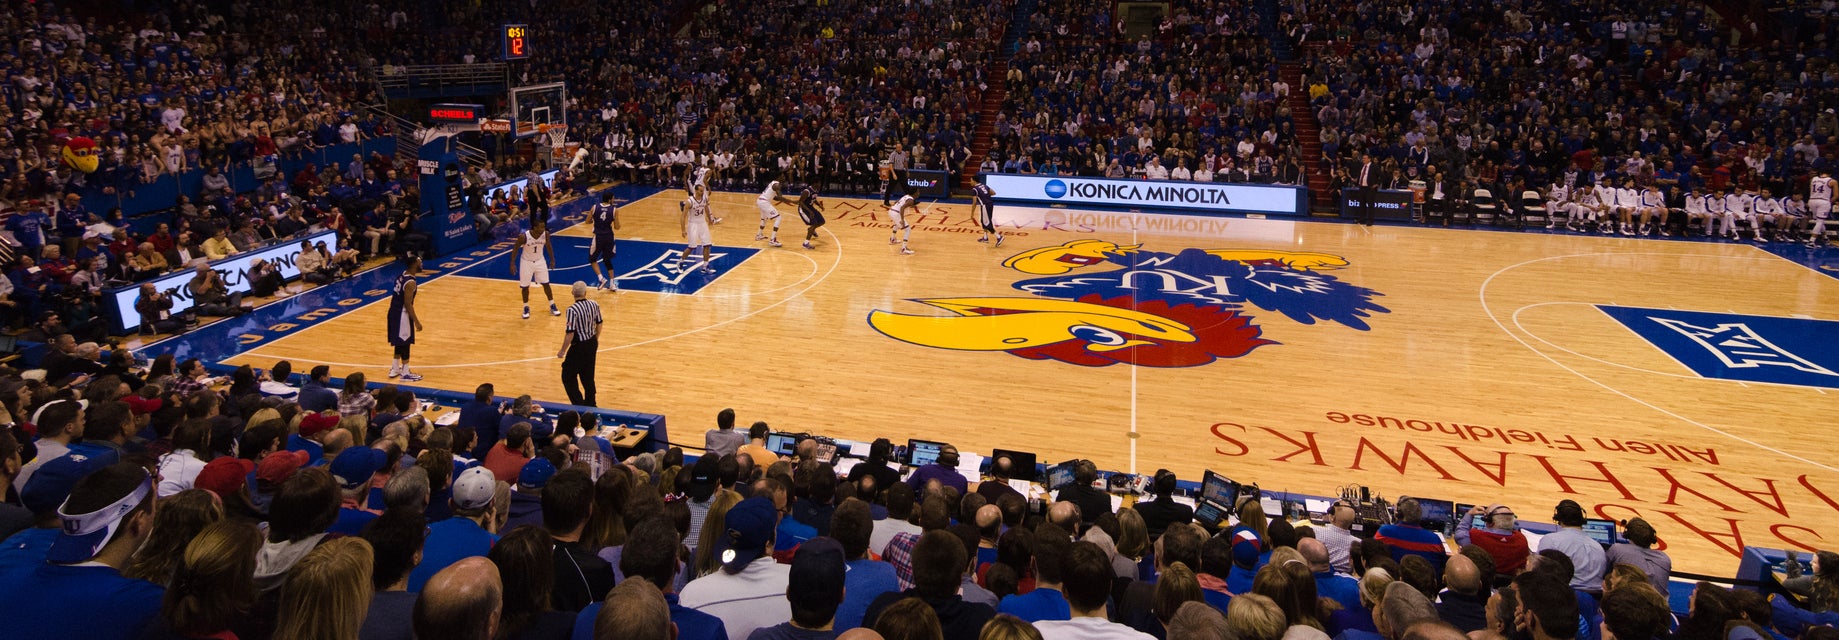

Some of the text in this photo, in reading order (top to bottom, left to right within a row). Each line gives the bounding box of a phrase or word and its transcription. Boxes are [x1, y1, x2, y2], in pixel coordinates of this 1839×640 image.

[508, 27, 525, 38] 10:51
[512, 38, 523, 55] 12
[430, 109, 474, 119] SCHEELS
[418, 160, 439, 168] MUSCLE
[420, 167, 435, 175] MILK
[907, 178, 930, 187] izhub
[1070, 182, 1231, 204] KONICA MINOLTA
[1812, 184, 1824, 193] 14
[600, 212, 607, 222] 4
[694, 209, 704, 217] 34
[533, 246, 537, 254] 1
[1115, 268, 1239, 298] KU
[239, 288, 389, 345] James
[1327, 411, 1721, 466] Allen Fieldhouse
